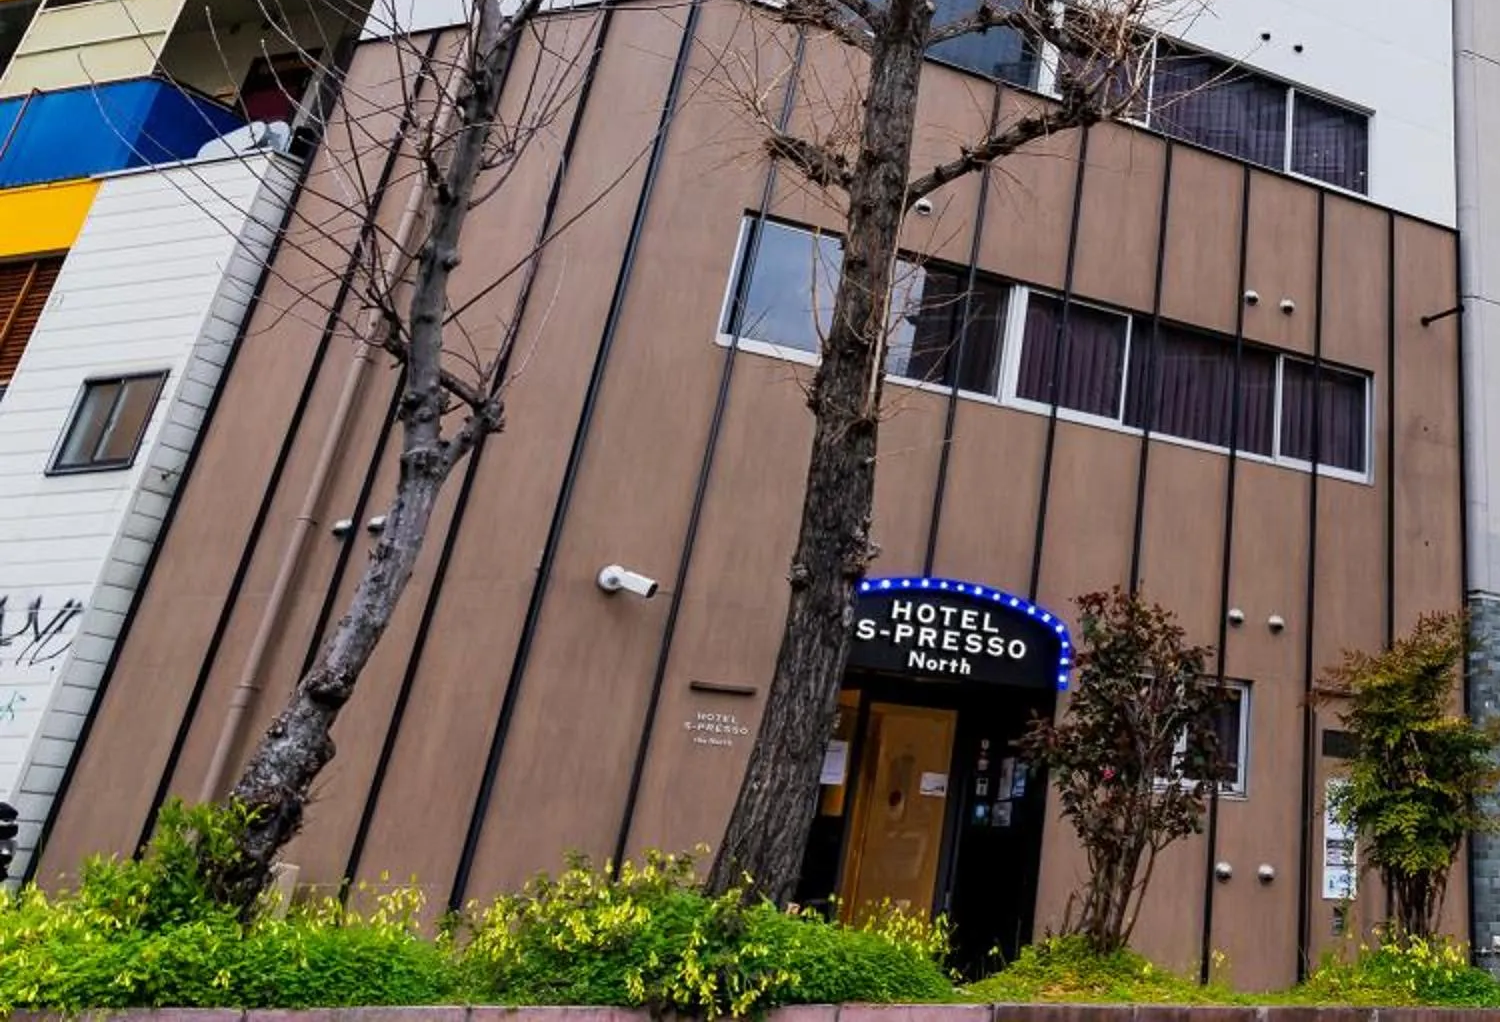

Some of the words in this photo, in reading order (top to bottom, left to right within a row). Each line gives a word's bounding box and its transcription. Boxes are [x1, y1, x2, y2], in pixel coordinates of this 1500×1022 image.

[891, 599, 999, 633] HOTEL
[856, 619, 1027, 659] S-PRESSO
[908, 650, 972, 675] North
[684, 721, 749, 735] S-PRESSO
[697, 711, 736, 723] HOTEL
